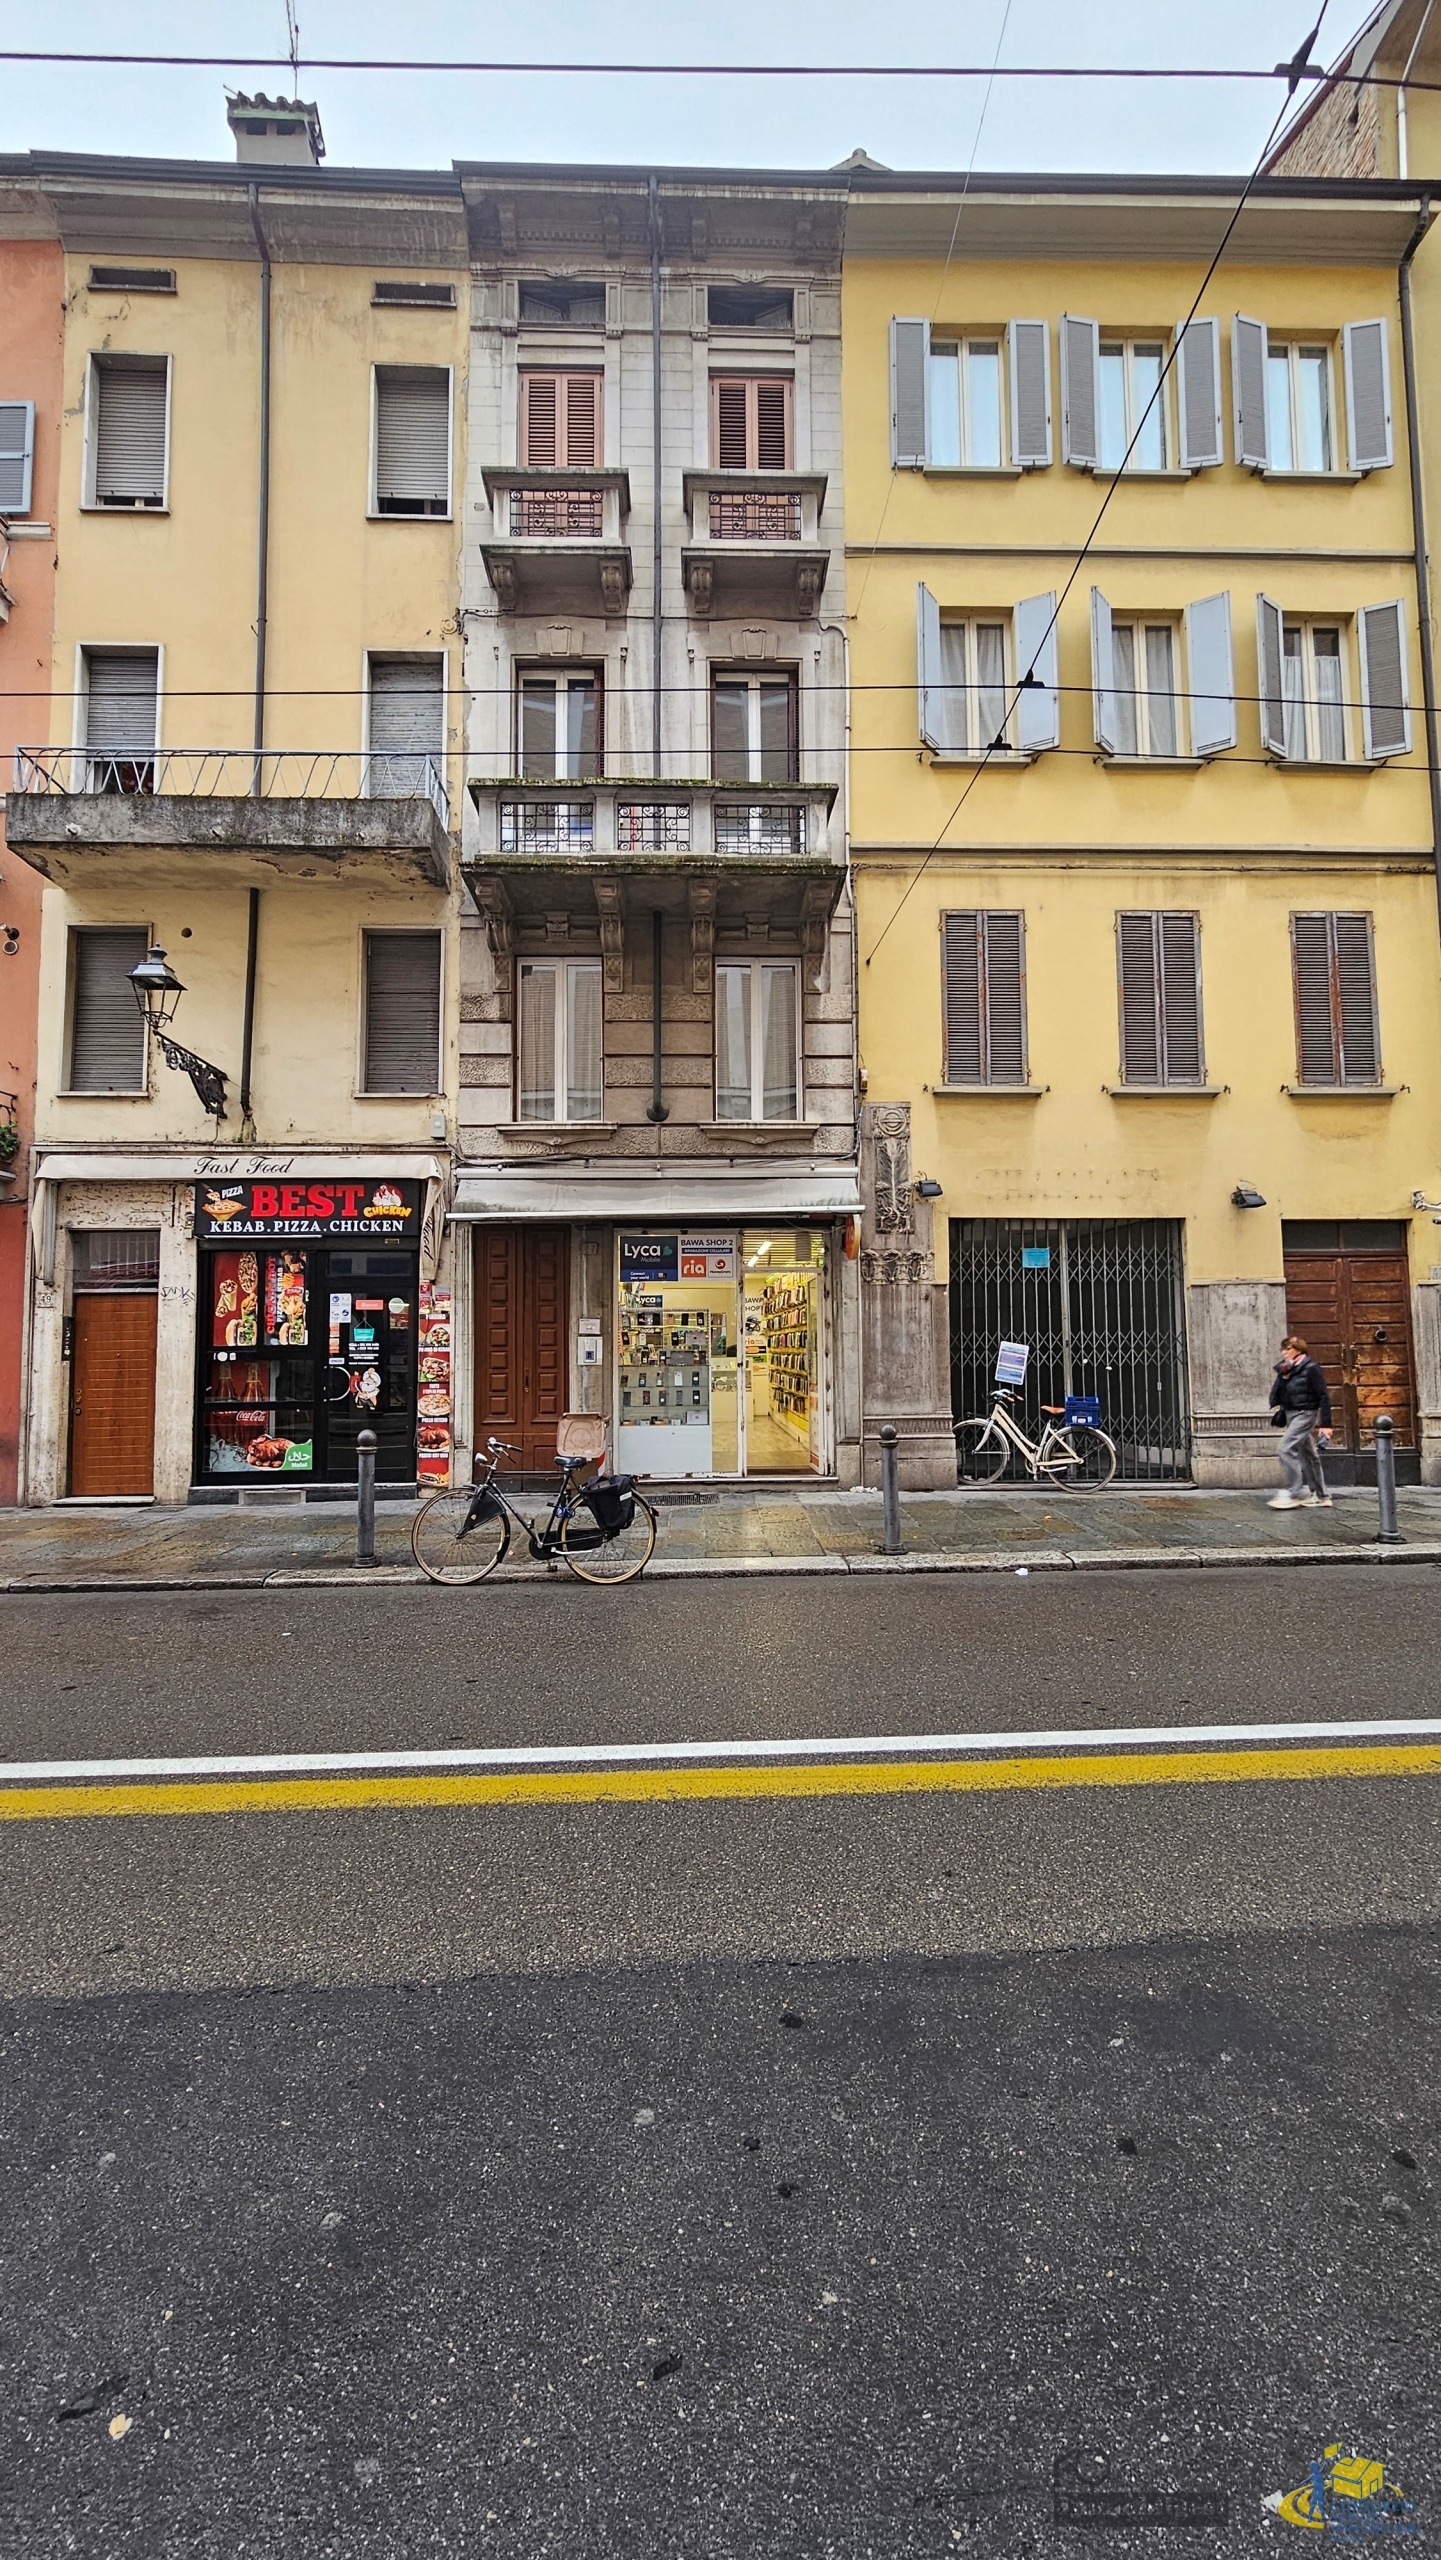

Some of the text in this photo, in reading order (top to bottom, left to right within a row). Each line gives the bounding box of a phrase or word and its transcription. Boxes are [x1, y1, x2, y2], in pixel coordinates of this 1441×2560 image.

[194, 1156, 294, 1175] Fast Food
[221, 1185, 244, 1199] PIZZA
[250, 1184, 365, 1218] BEST
[363, 1204, 413, 1218] CHICKEN
[329, 1219, 404, 1232] CHICKEN
[624, 1243, 661, 1259] Lyca
[683, 1260, 705, 1274] ria
[40, 1295, 52, 1303] 49
[288, 1451, 311, 1462] حلال
